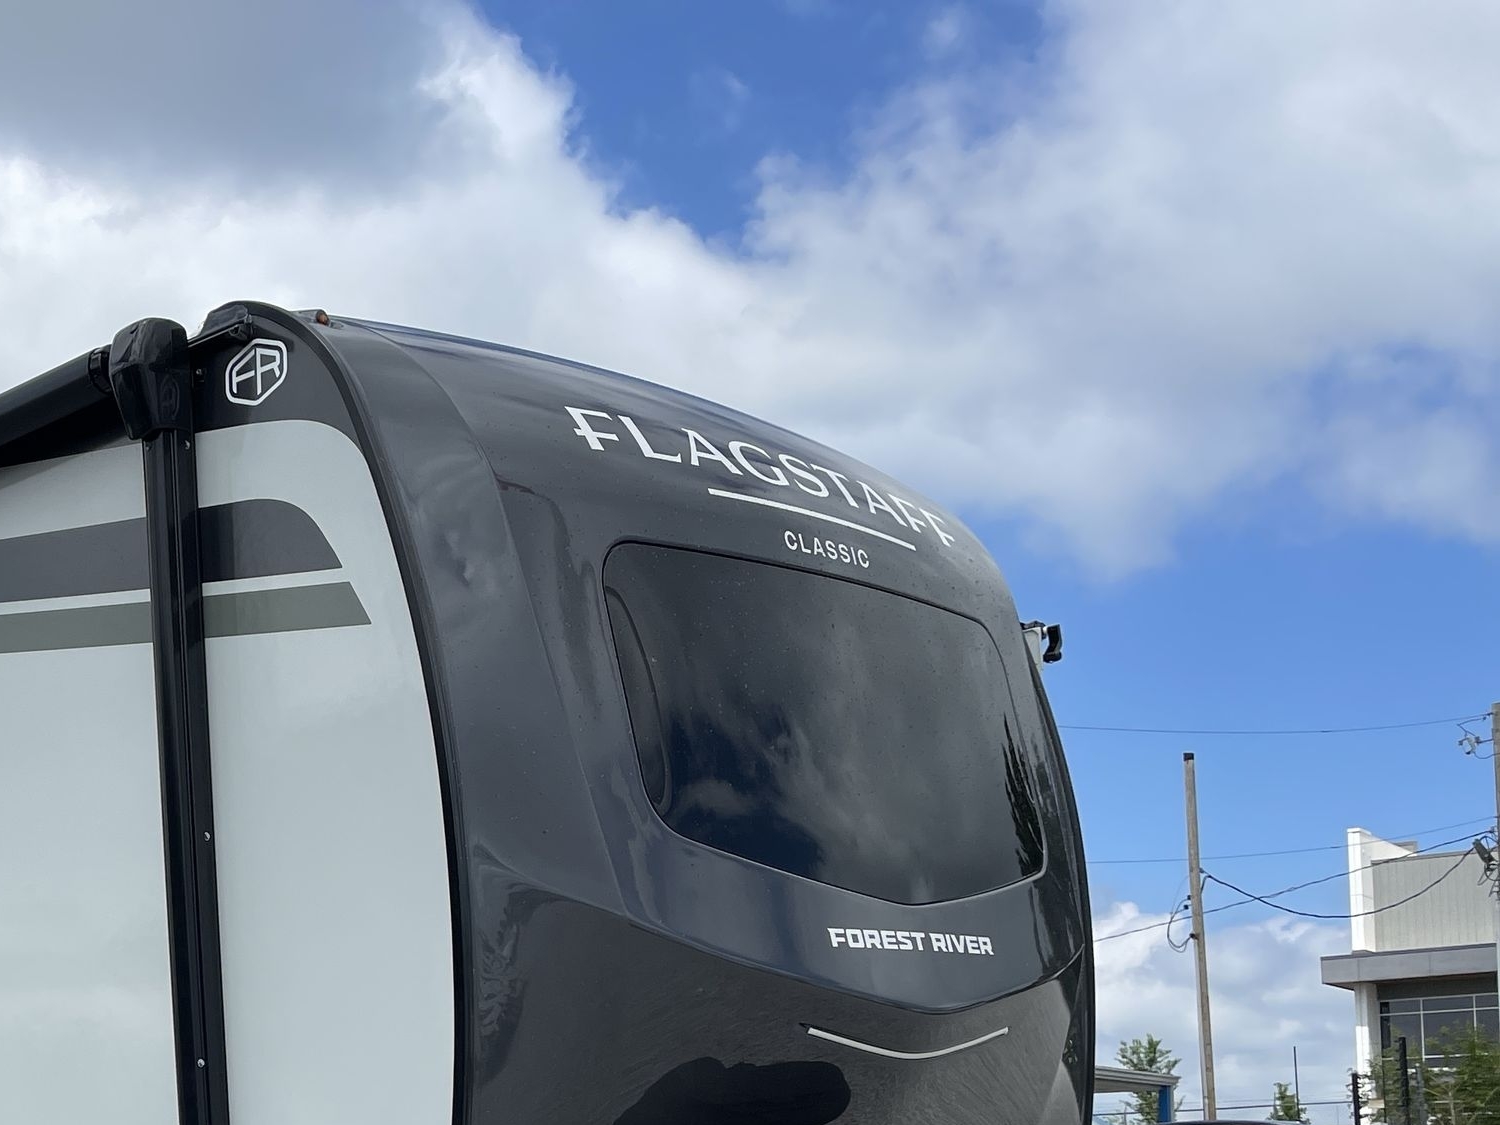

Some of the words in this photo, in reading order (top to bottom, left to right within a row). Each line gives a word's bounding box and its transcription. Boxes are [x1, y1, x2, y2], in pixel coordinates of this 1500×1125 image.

[564, 406, 956, 547] FLAGSTAFF
[784, 530, 870, 568] CLASSIC
[827, 927, 925, 951] FOREST
[929, 932, 995, 955] RIVER
